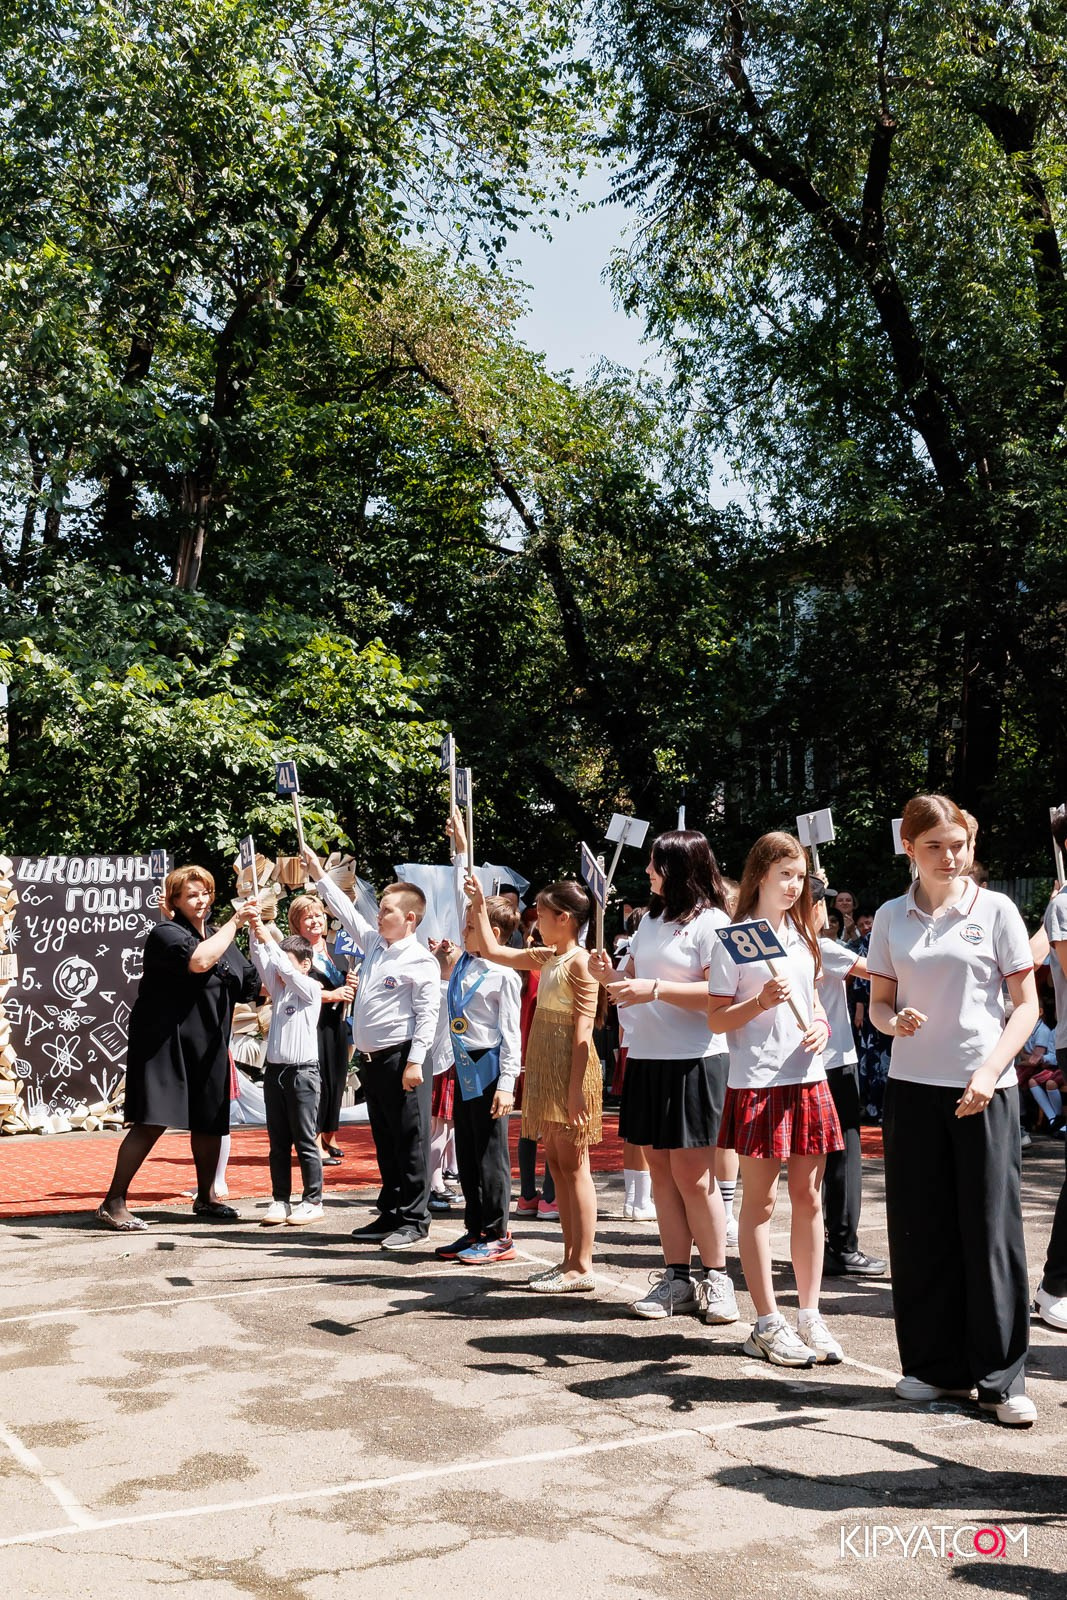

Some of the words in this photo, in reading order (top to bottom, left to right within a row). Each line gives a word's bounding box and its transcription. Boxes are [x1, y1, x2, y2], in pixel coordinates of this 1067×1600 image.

[278, 766, 296, 789] 4L
[457, 773, 467, 801] 6L
[153, 854, 163, 874] 2L
[65, 886, 142, 915] ГОДЫ
[730, 927, 781, 958] 8L
[87, 1049, 98, 1063] 2
